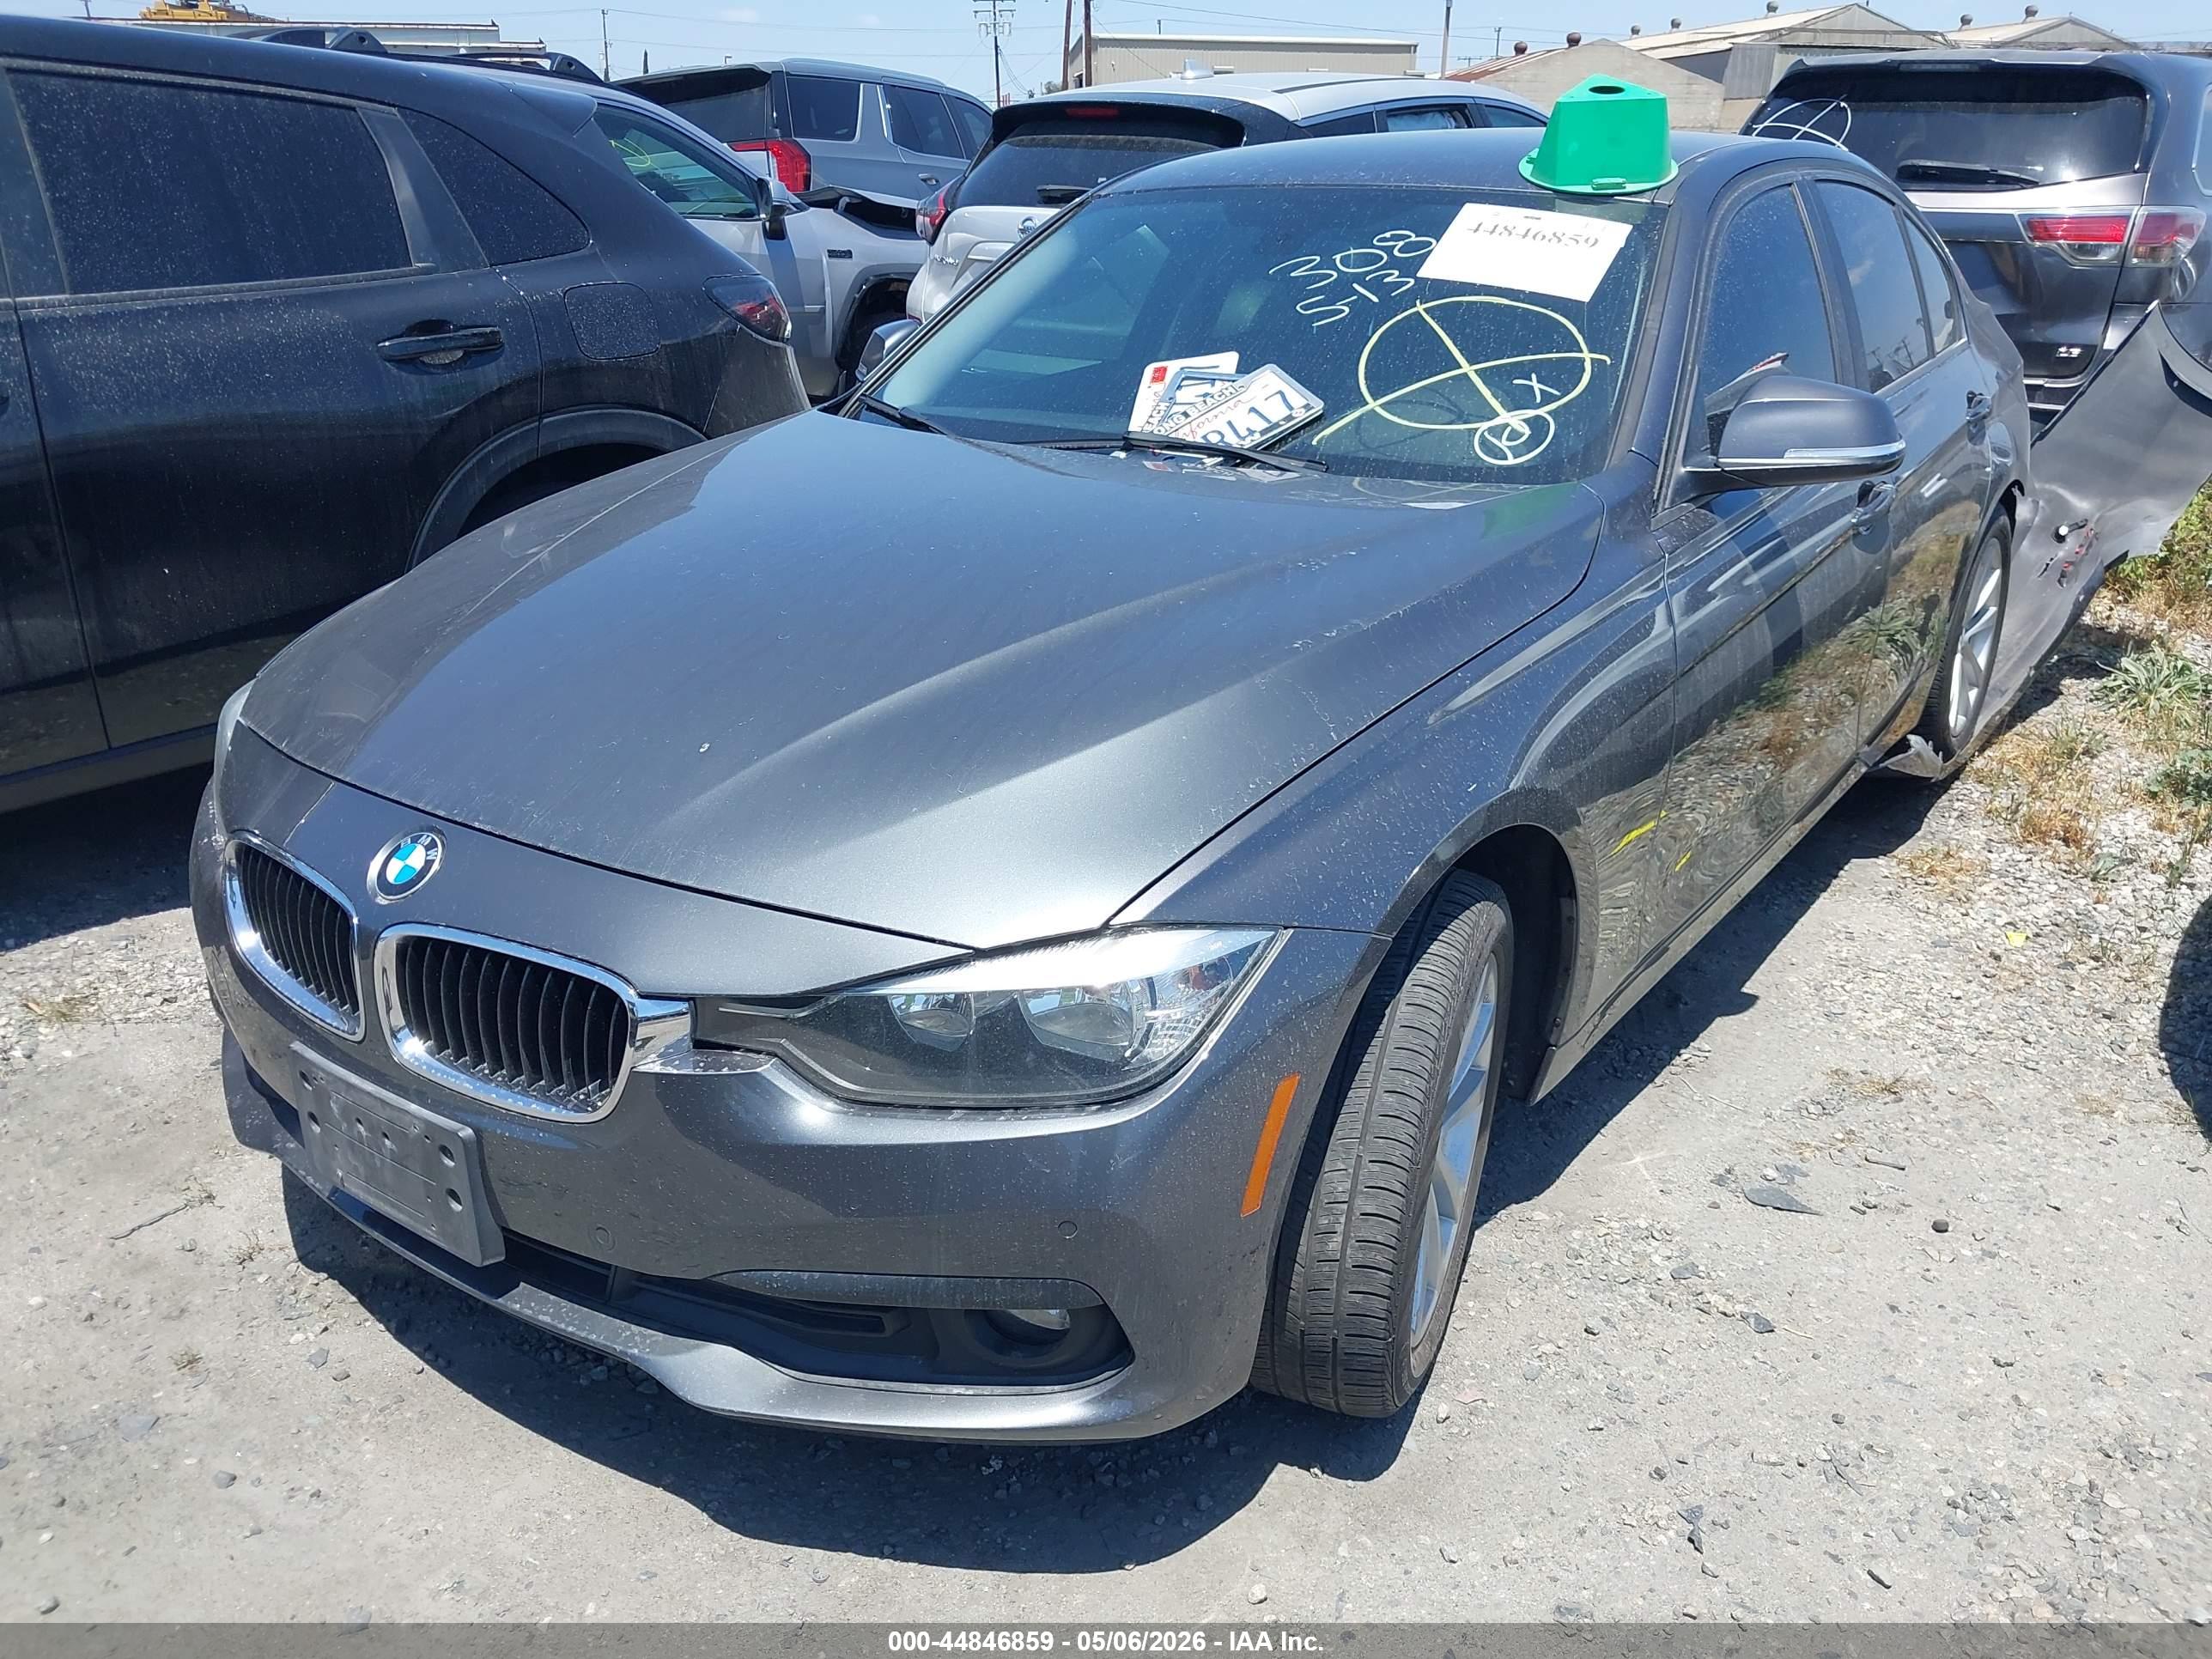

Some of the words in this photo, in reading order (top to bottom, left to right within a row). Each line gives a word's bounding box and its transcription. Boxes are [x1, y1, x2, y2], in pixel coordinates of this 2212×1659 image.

[1268, 229, 1438, 290] 308
[1467, 221, 1600, 248] 44846859
[1141, 401, 1169, 434] EACH
[1152, 412, 1188, 436] ONG
[1184, 383, 1238, 420] BEACH
[1200, 389, 1295, 447] R417
